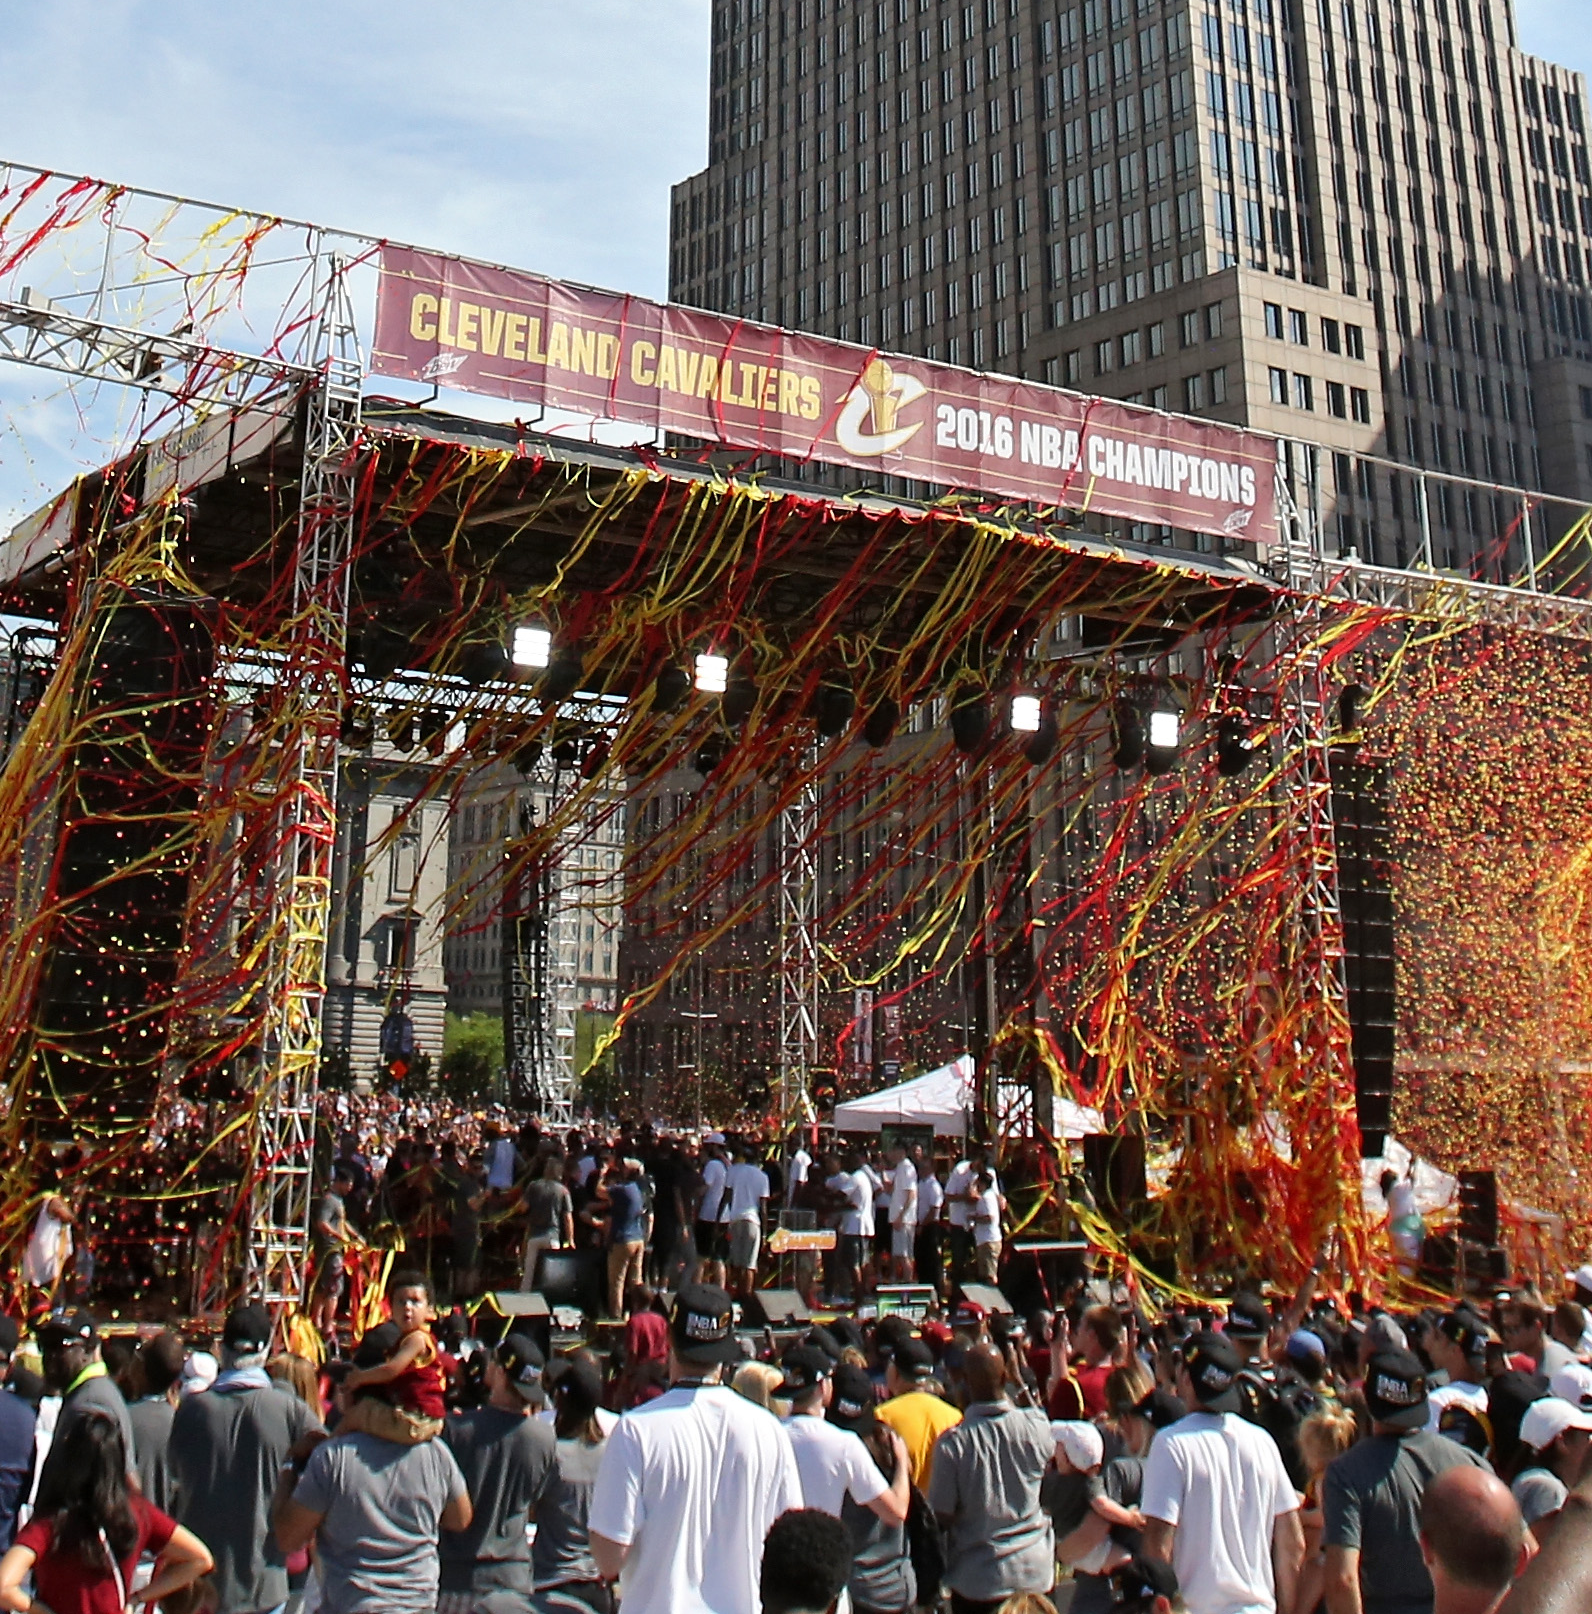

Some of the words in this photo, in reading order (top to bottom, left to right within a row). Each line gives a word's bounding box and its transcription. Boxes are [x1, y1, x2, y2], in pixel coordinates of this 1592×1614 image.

[409, 292, 622, 381] CLEVELAND
[630, 339, 821, 421] CAVALIERS
[935, 403, 1014, 460] 2016
[1019, 419, 1083, 473] NBA
[1087, 434, 1256, 507] CHAMPIONS
